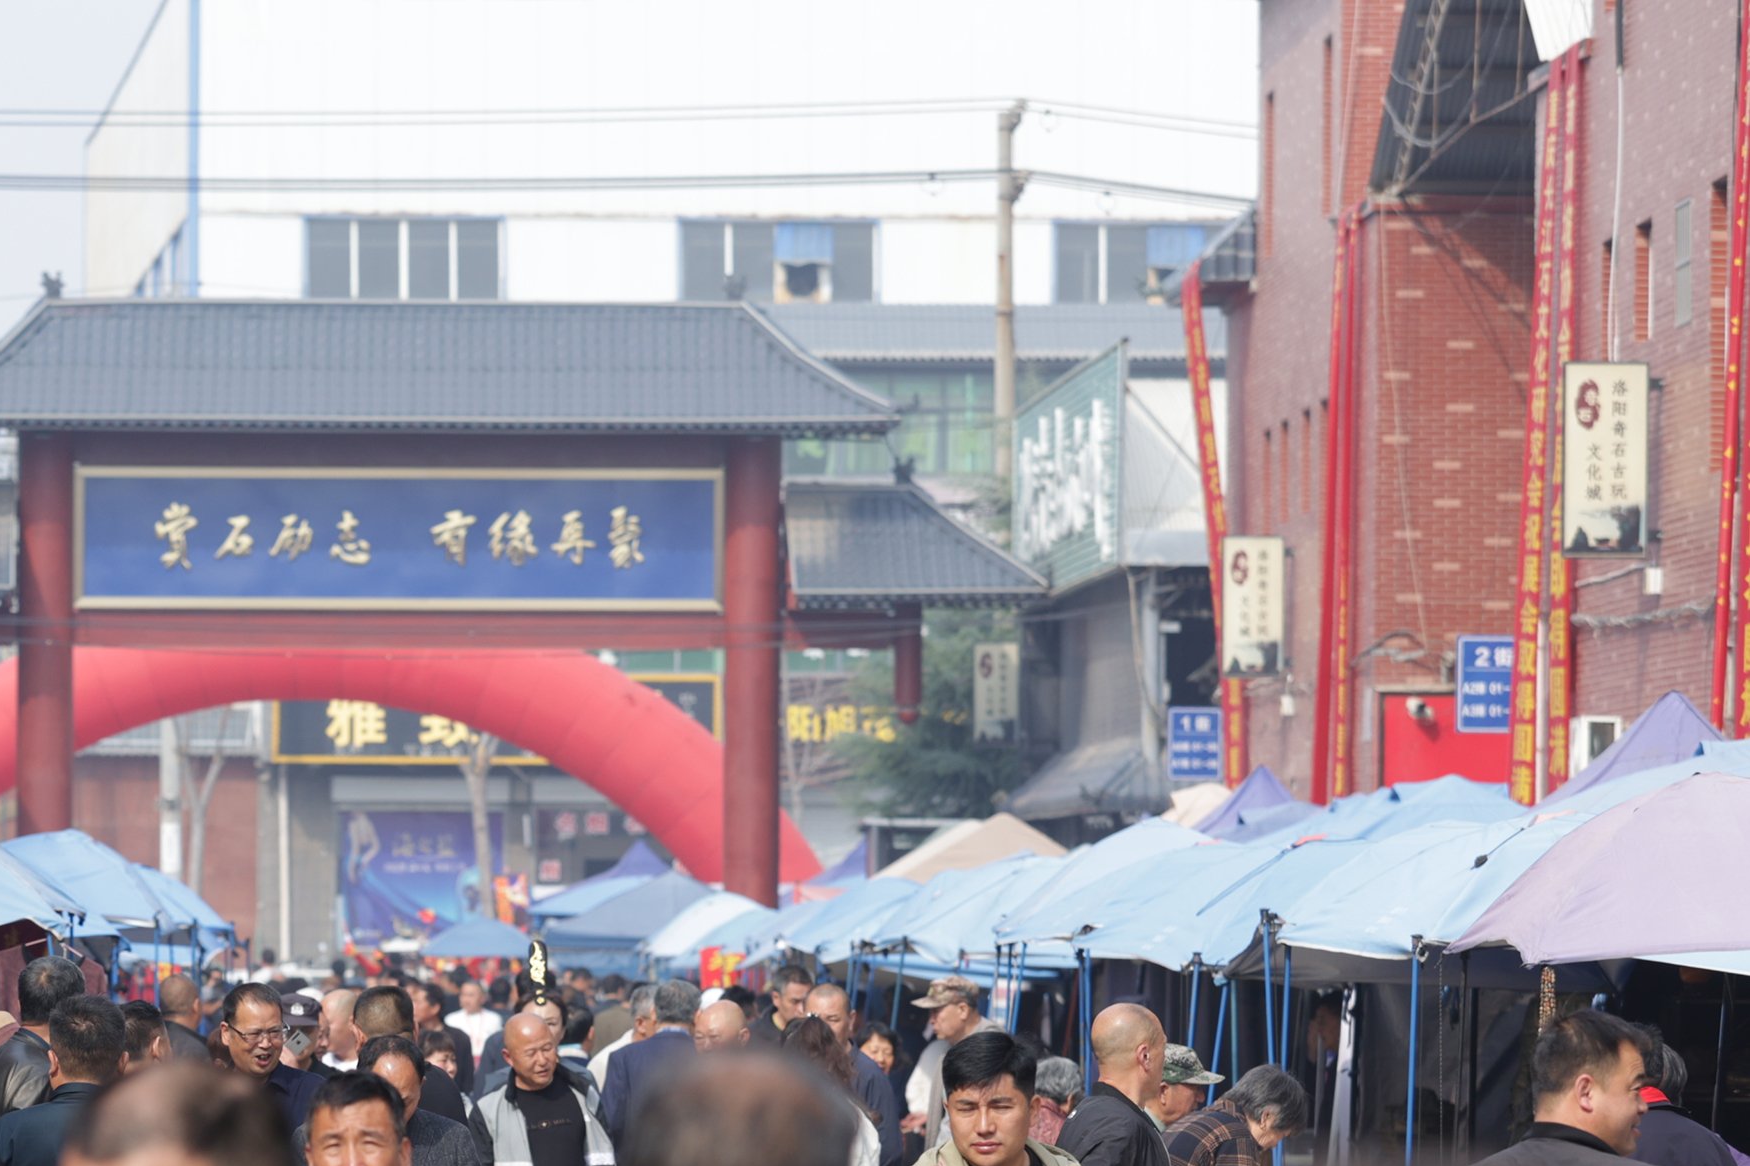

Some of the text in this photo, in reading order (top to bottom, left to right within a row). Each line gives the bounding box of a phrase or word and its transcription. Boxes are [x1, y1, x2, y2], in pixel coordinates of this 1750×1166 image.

[1610, 379, 1628, 500] 洛阳奇石古玩
